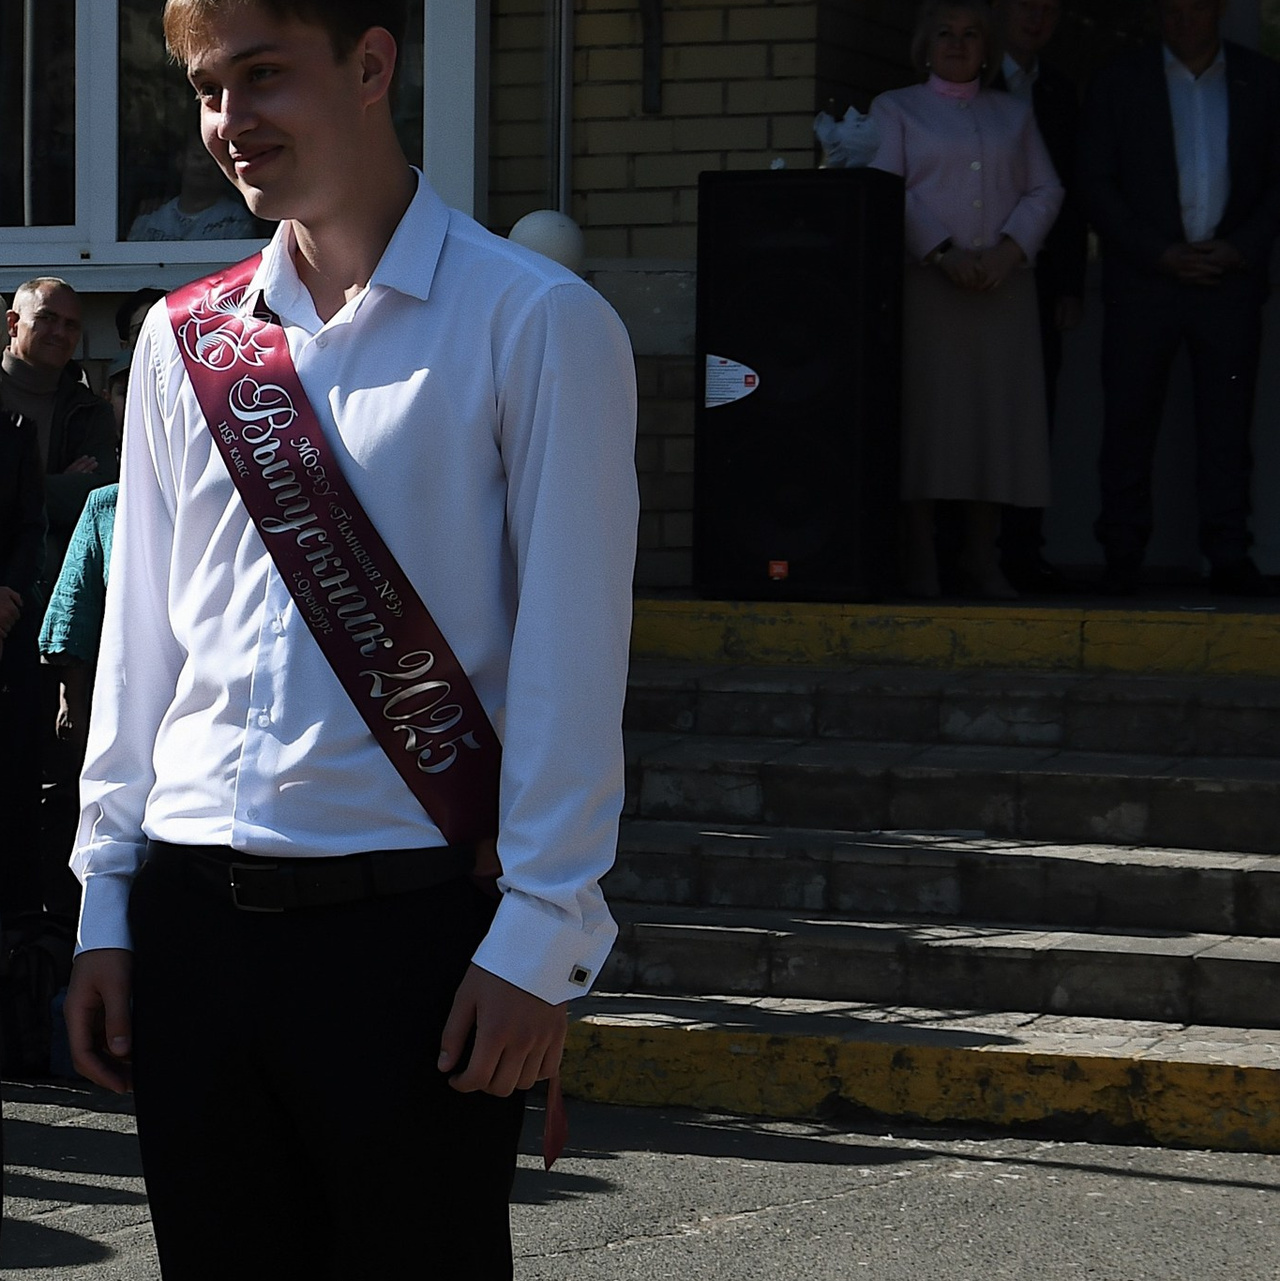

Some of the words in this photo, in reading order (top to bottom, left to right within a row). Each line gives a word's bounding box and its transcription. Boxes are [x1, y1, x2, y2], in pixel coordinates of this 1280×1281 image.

[228, 446, 251, 479] класс
[290, 436, 339, 496] МОАУ
[328, 501, 381, 582] «Гимназия
[374, 578, 404, 618] №3»
[228, 373, 394, 658] Выпускник
[358, 650, 482, 774] 2025
